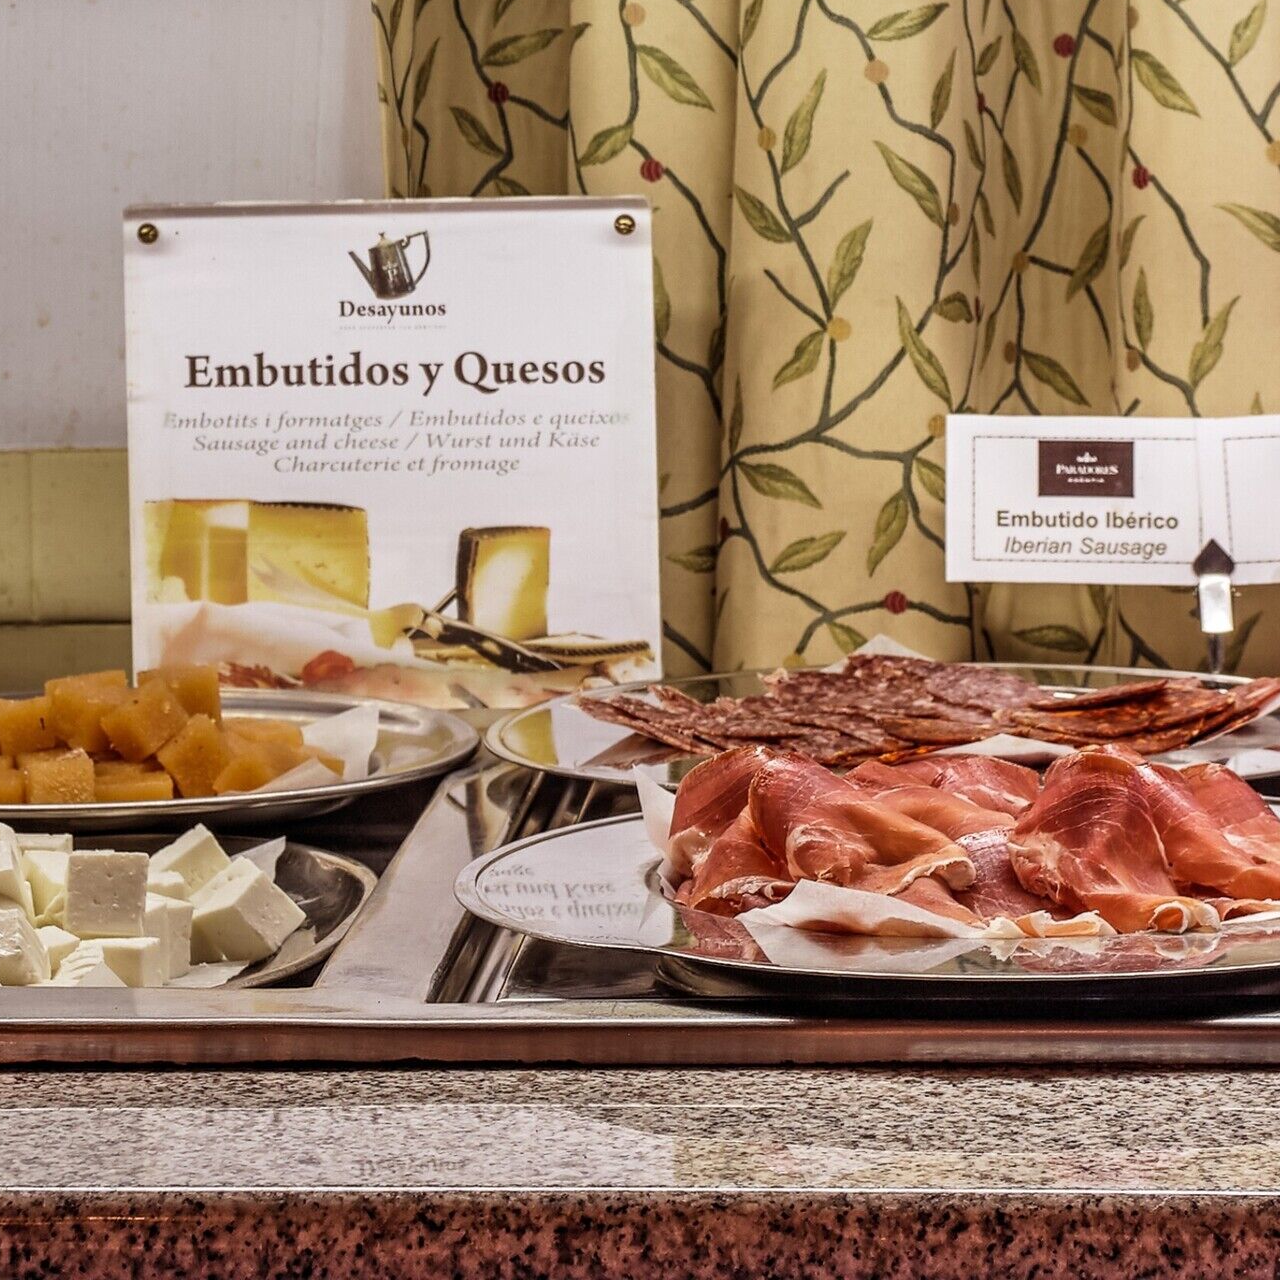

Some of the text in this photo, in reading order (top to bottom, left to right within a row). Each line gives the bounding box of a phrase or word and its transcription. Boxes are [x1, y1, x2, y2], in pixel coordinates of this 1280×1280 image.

[338, 300, 447, 325] Desayunos
[184, 350, 606, 397] Embutidos y Quesos
[163, 411, 258, 429] Embotits
[273, 410, 383, 433] formatges
[409, 409, 527, 427] Embutidos
[533, 414, 544, 426] e
[192, 434, 280, 457] Sausage
[286, 432, 329, 451] and
[334, 432, 400, 451] cheese
[426, 432, 492, 449] Wurst
[498, 431, 542, 449] und
[548, 431, 601, 449] Käse
[274, 455, 521, 477] Charcuterie et fromage
[996, 509, 1179, 530] Embutido Ibérico
[1004, 536, 1168, 561] Iberian Sausage
